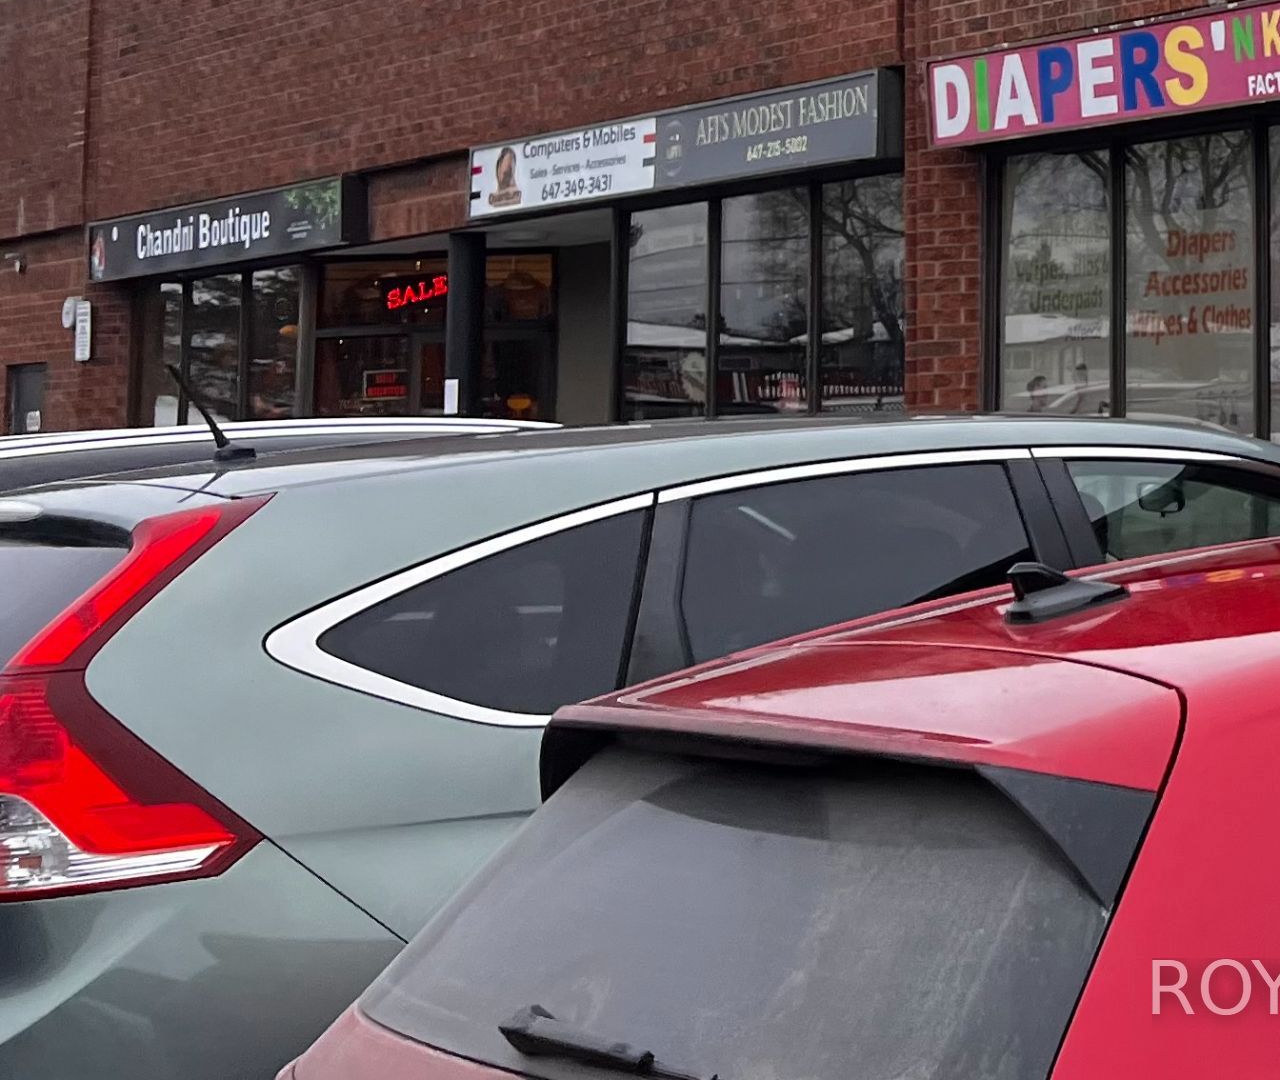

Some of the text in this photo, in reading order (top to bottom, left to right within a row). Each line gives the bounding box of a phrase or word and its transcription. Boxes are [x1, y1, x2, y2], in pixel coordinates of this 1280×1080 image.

[932, 24, 1209, 139] DIAPERS
[732, 100, 795, 139] MODEST
[799, 85, 870, 127] FASHION
[522, 125, 636, 159] Computers & Mobiles
[541, 174, 613, 201] 647-349-3431
[136, 215, 194, 260] Chandni
[199, 207, 271, 249] Boutique
[1166, 230, 1236, 263] Diapers
[386, 274, 449, 310] SALE
[1143, 264, 1248, 298] Accessories
[1186, 305, 1198, 334] &
[1202, 303, 1252, 333] Clothes
